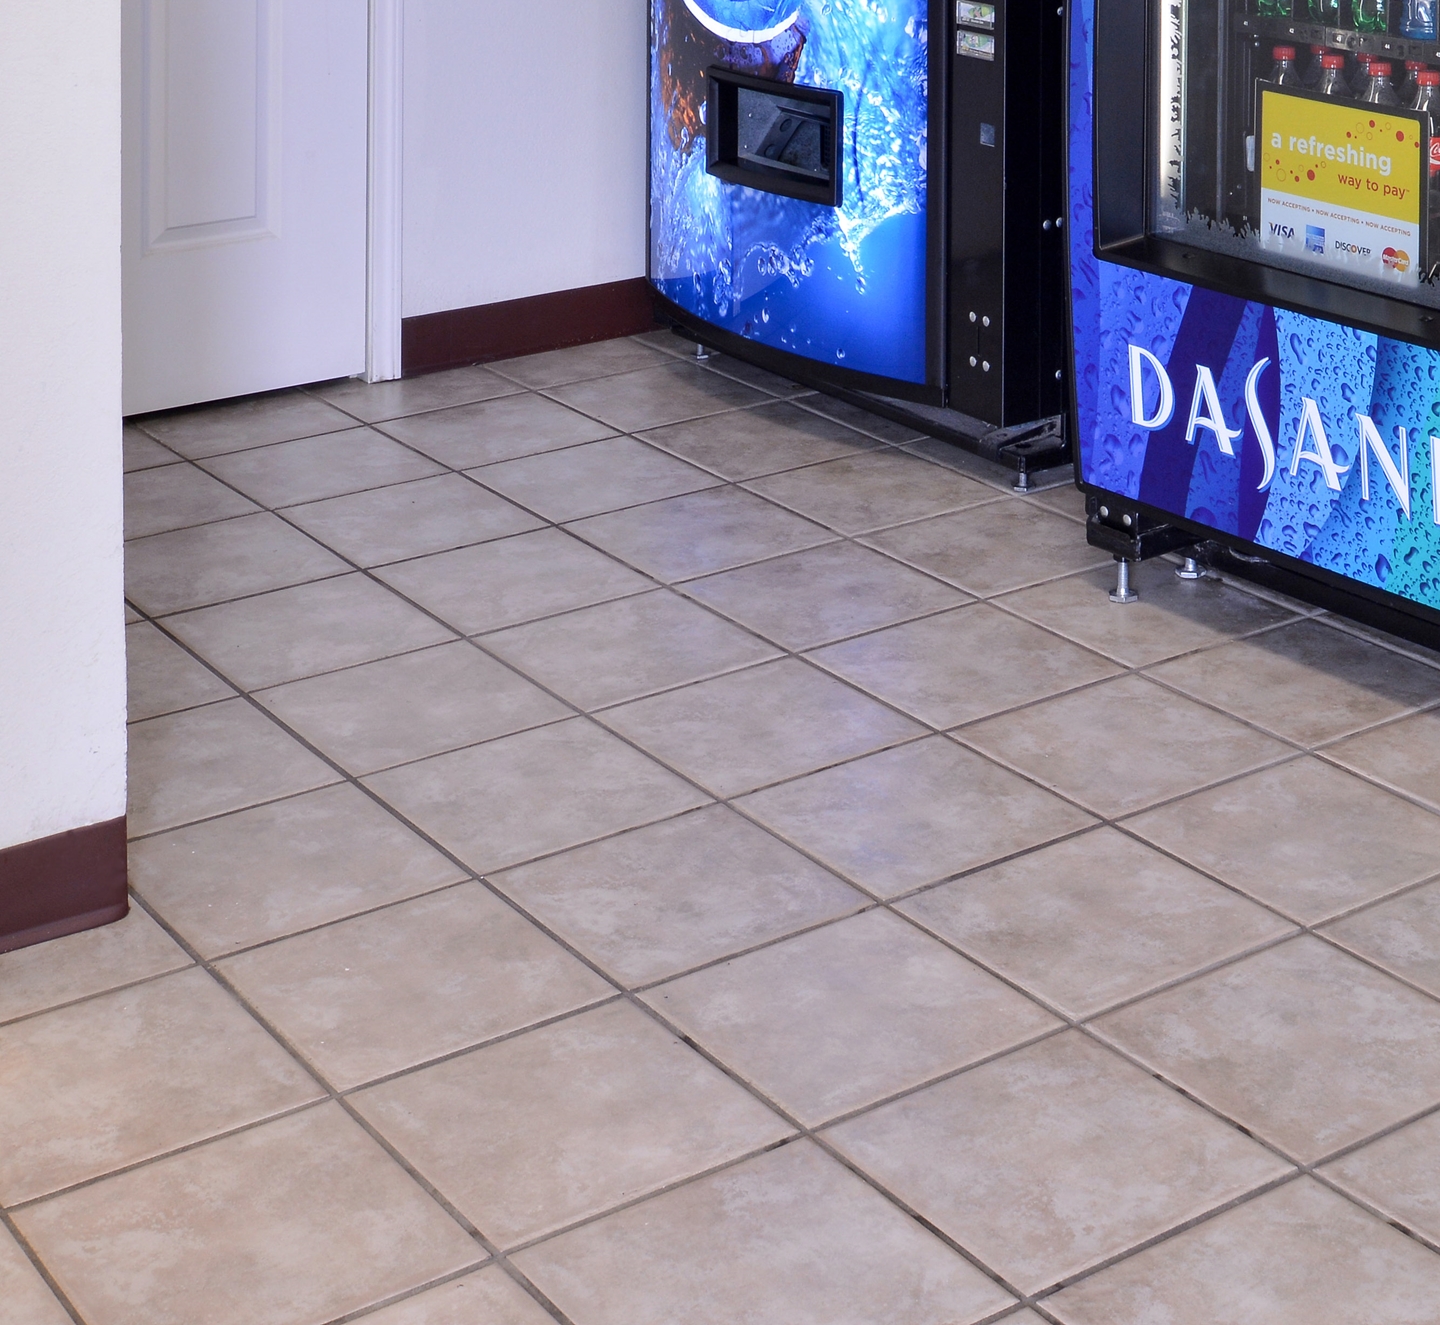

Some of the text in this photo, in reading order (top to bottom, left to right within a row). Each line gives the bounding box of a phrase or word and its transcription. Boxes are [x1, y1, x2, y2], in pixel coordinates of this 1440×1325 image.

[1271, 131, 1392, 177] a refreshing
[1337, 173, 1406, 200] way to pay
[1267, 197, 1411, 236] NOW ACCEPTING NOW ACCEPTING NOW ACCEPTING
[1268, 221, 1295, 239] VISA
[1335, 240, 1371, 257] DISCOVER
